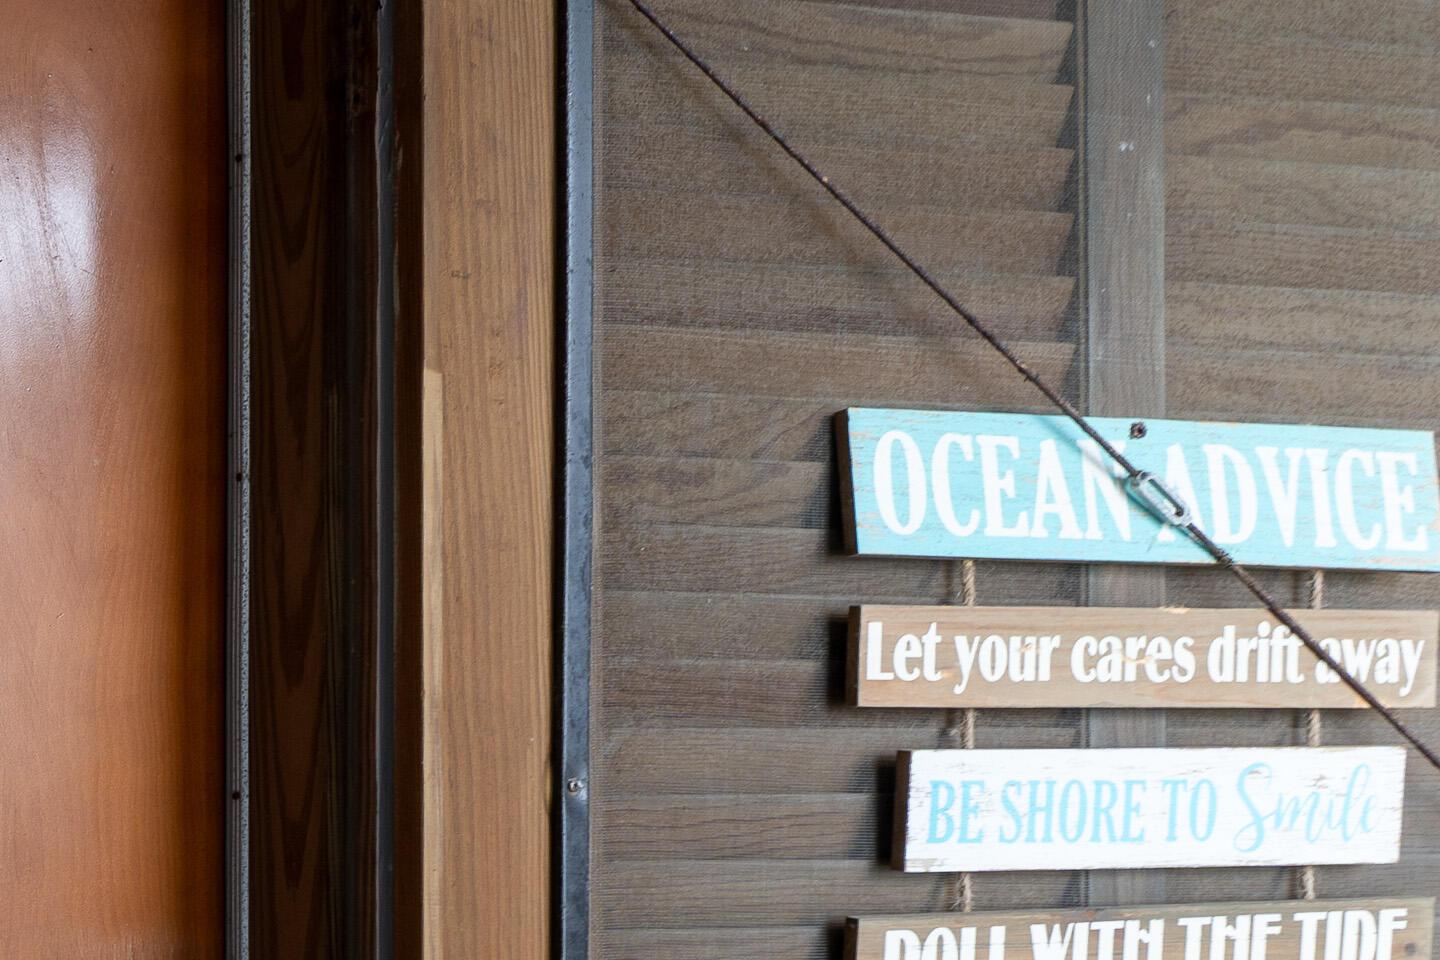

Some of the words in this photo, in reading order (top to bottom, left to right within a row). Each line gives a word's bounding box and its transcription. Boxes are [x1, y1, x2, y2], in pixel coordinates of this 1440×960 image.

[872, 429, 1132, 541] OCEAN
[1157, 443, 1428, 551] ADVICE
[865, 621, 942, 682] Let
[953, 633, 1060, 695] your
[1071, 632, 1196, 684] cares
[1207, 622, 1305, 684] drift
[1317, 638, 1425, 697] away
[926, 779, 984, 844] BE
[999, 778, 1146, 843] SHORE
[1161, 778, 1218, 842] TO
[1234, 762, 1377, 852] Smile
